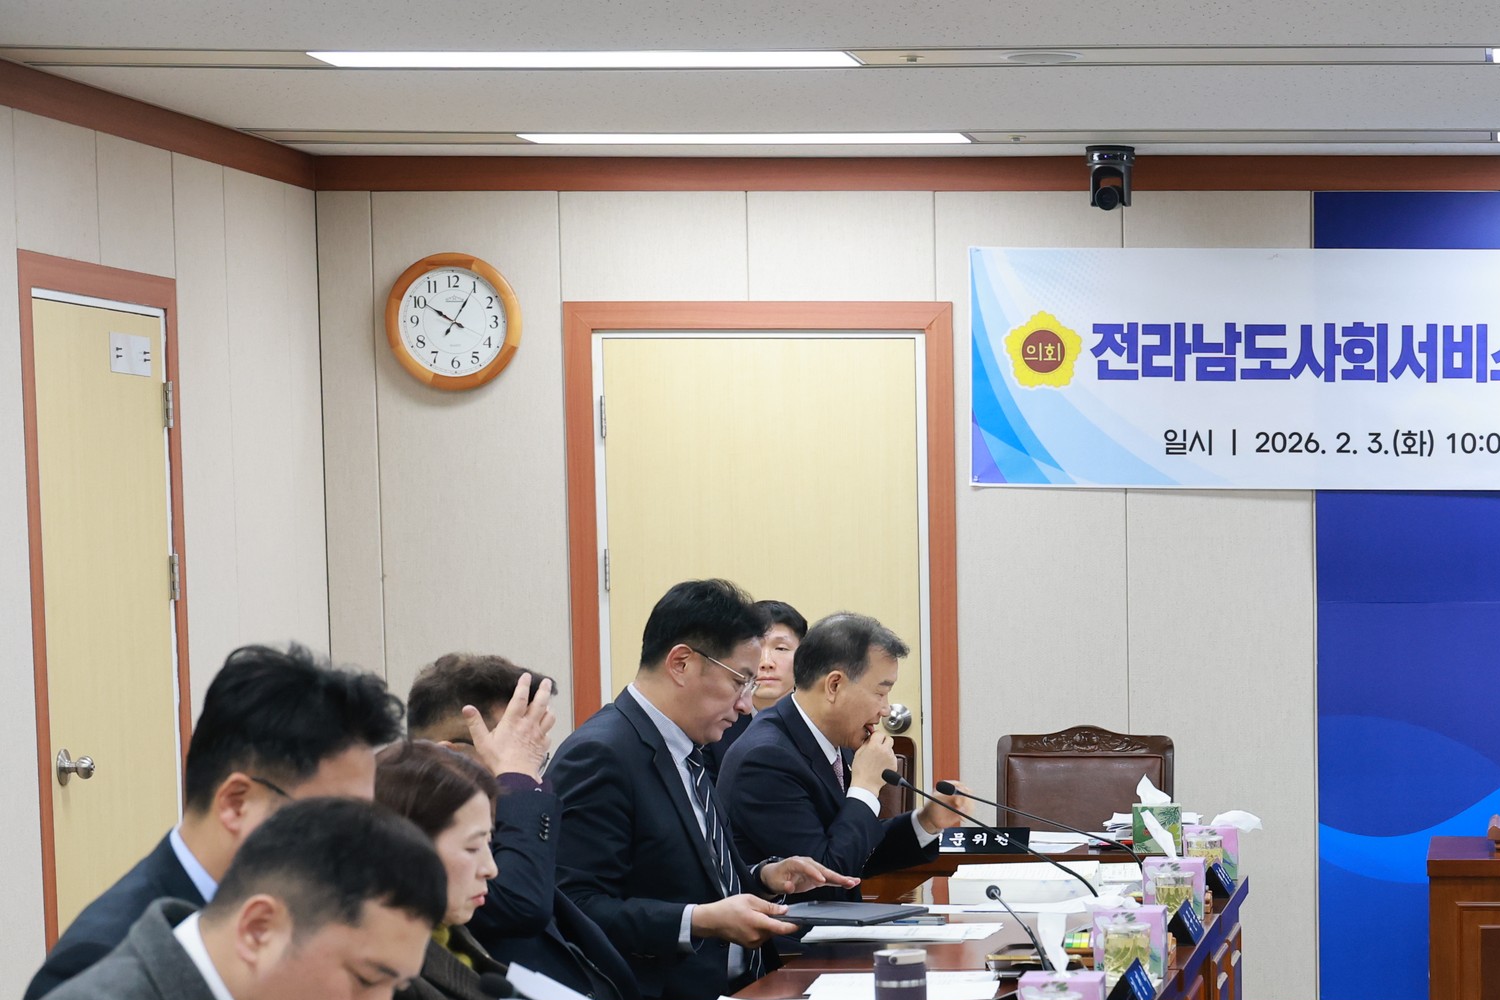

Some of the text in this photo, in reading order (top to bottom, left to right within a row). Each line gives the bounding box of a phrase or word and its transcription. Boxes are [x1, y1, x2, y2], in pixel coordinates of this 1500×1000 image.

[427, 281, 437, 294] 11
[447, 275, 460, 288] 12
[413, 296, 427, 308] 10
[486, 296, 493, 309] 2
[410, 315, 419, 327] 9
[489, 315, 499, 329] 3
[416, 335, 426, 348] 8
[483, 336, 492, 349] 4
[431, 351, 439, 364] 7
[471, 352, 480, 365] 5
[1024, 345, 1061, 362] 의회
[451, 356, 461, 369] 6
[1163, 429, 1213, 455] 일시
[1255, 432, 1327, 454] 2026.
[1336, 432, 1358, 454] 2.
